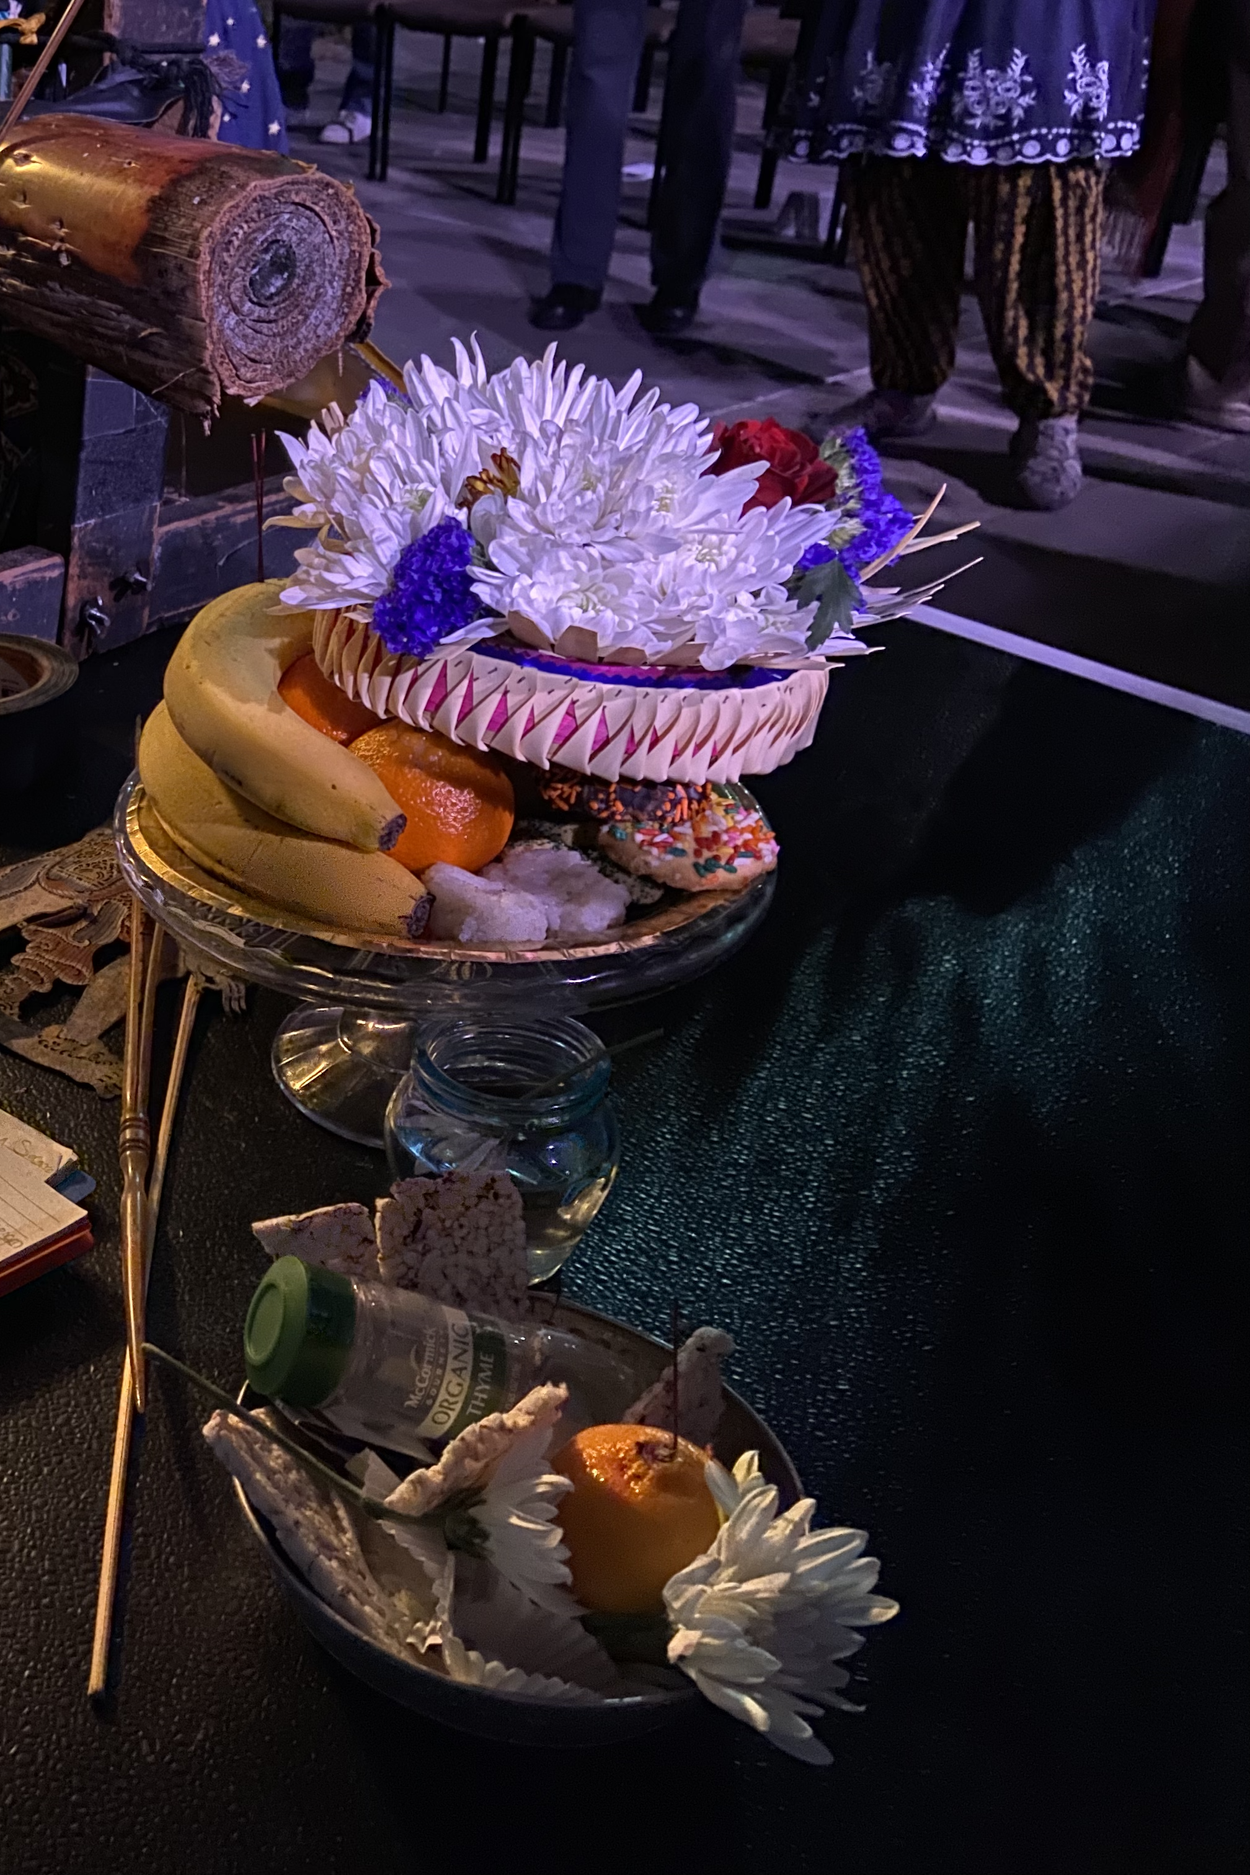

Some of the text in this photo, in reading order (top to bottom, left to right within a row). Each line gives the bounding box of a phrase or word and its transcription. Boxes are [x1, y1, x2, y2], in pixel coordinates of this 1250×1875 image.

[403, 1327, 438, 1409] McCormick
[431, 1322, 471, 1426] ORGANIC
[465, 1351, 495, 1416] THYME
